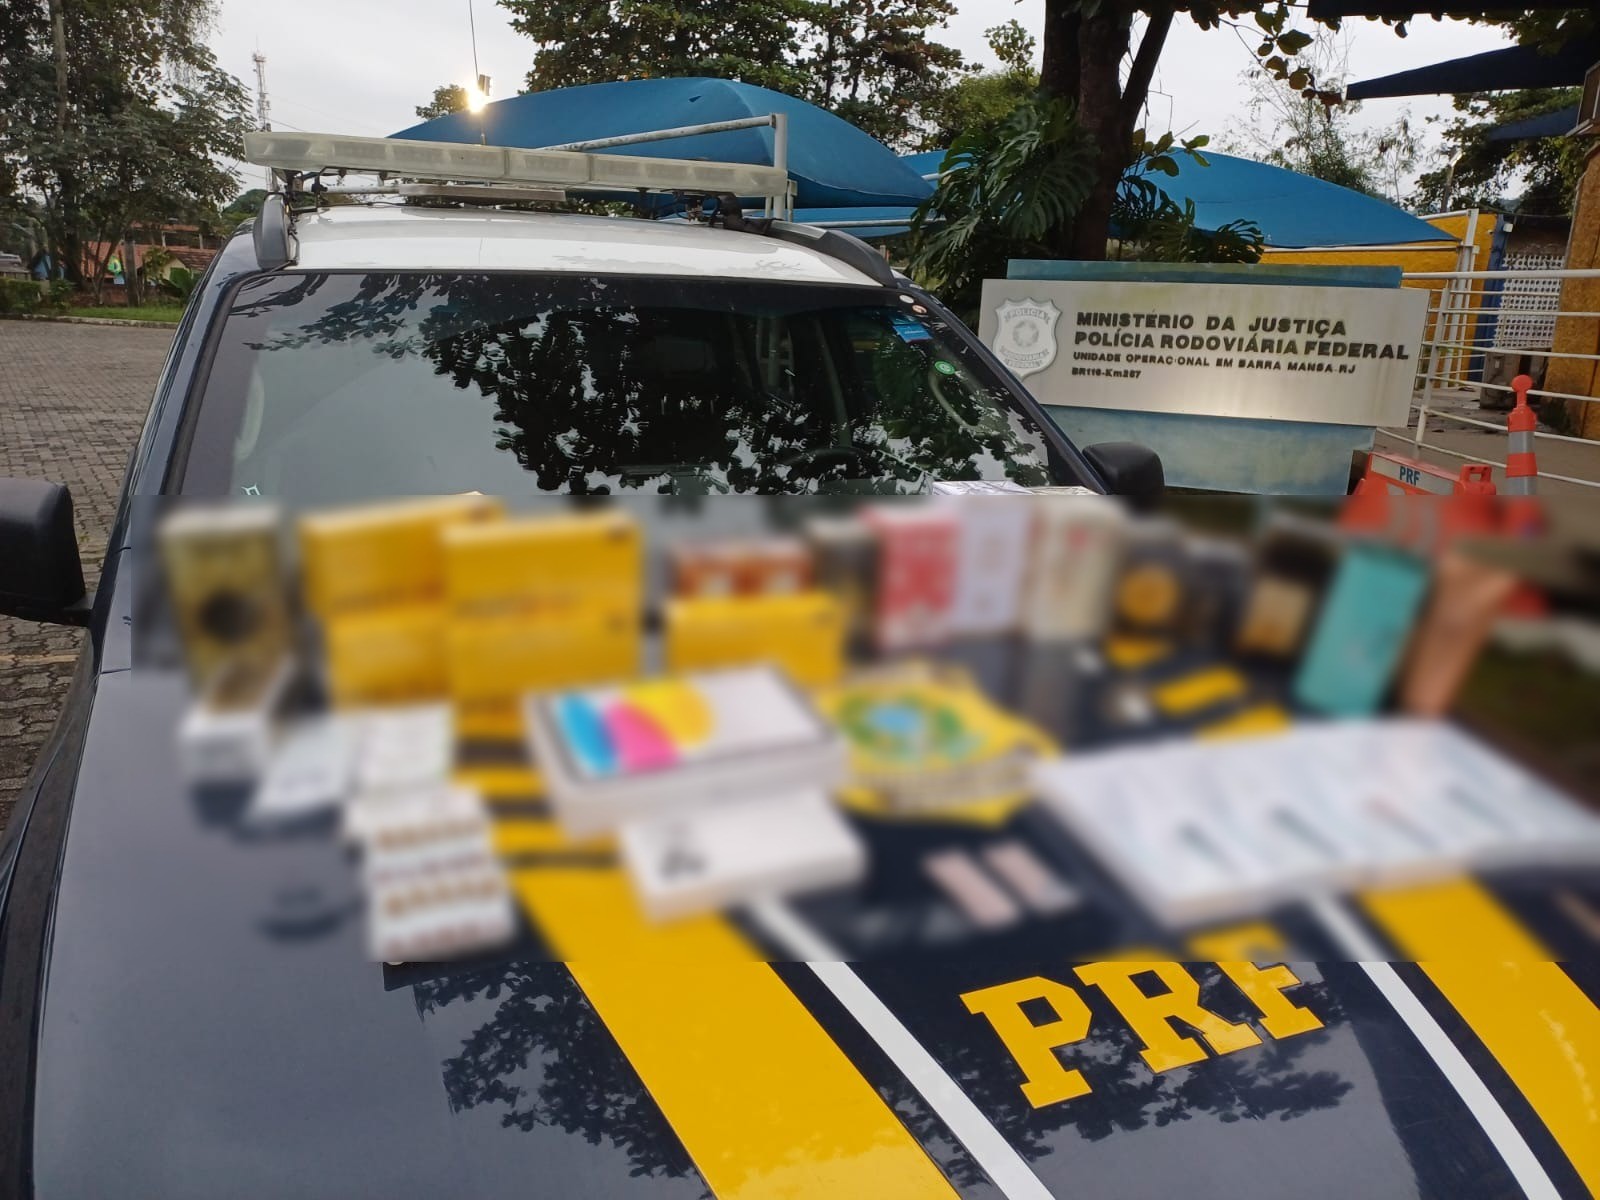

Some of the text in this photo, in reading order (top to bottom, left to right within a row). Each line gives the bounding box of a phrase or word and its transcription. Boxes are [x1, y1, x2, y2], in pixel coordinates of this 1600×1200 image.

[1076, 309, 1346, 338] MINISTÉRIO DA JUSTIÇA
[1074, 328, 1409, 360] POLÍCIA RODOVIÁRIA FEDERAL
[1073, 352, 1121, 362] UNIDADE
[1216, 358, 1233, 367] EM
[1238, 359, 1281, 370] BARRA
[1400, 466, 1421, 486] PRF
[959, 921, 1325, 1109] PRF
